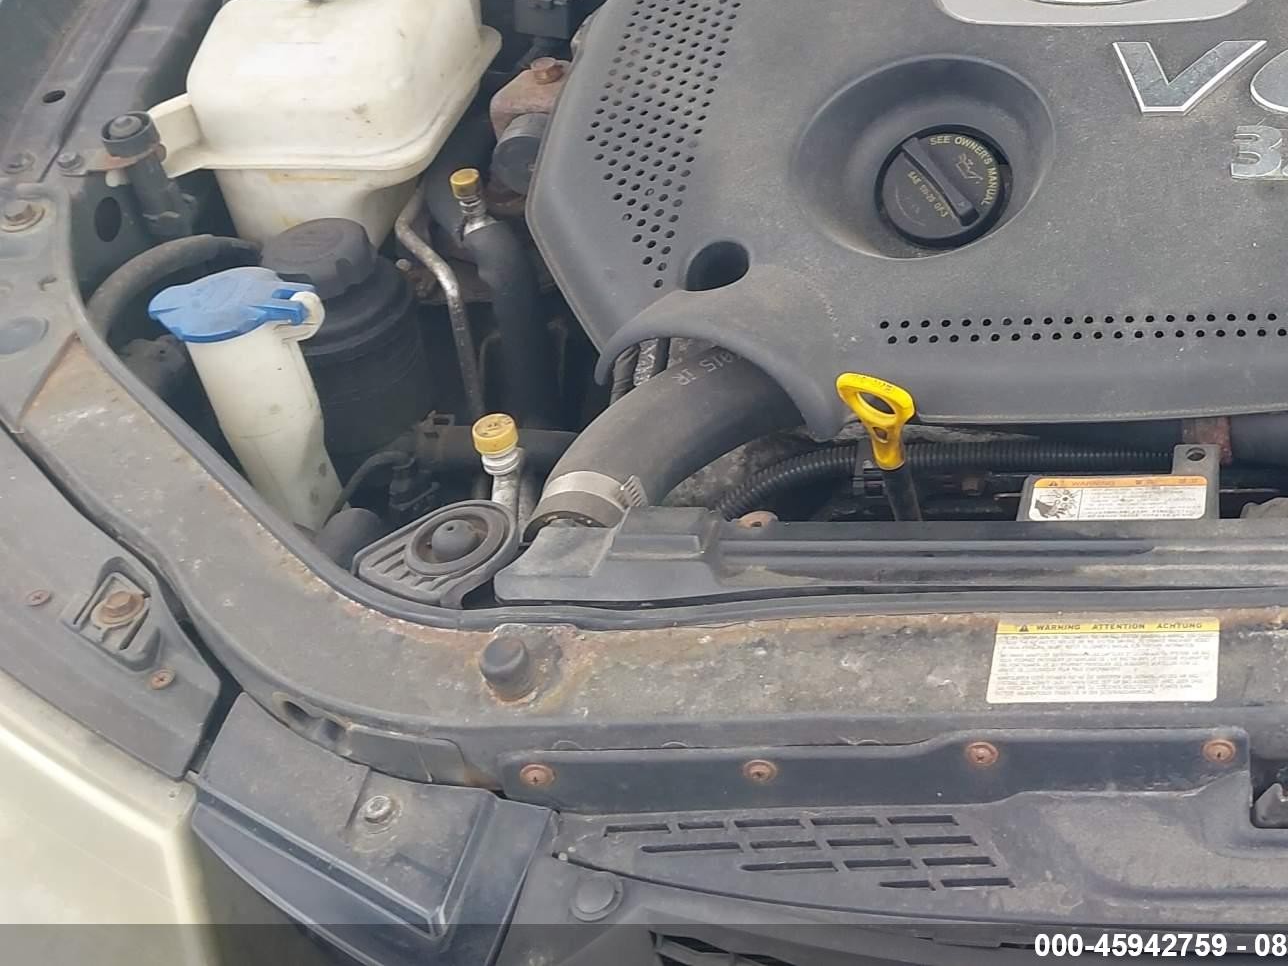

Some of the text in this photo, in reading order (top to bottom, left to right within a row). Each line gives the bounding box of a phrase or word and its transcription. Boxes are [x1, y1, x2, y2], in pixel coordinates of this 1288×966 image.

[929, 135, 998, 206] SEE OWNER'S MANUAL
[1156, 622, 1203, 630] ACHTUNG
